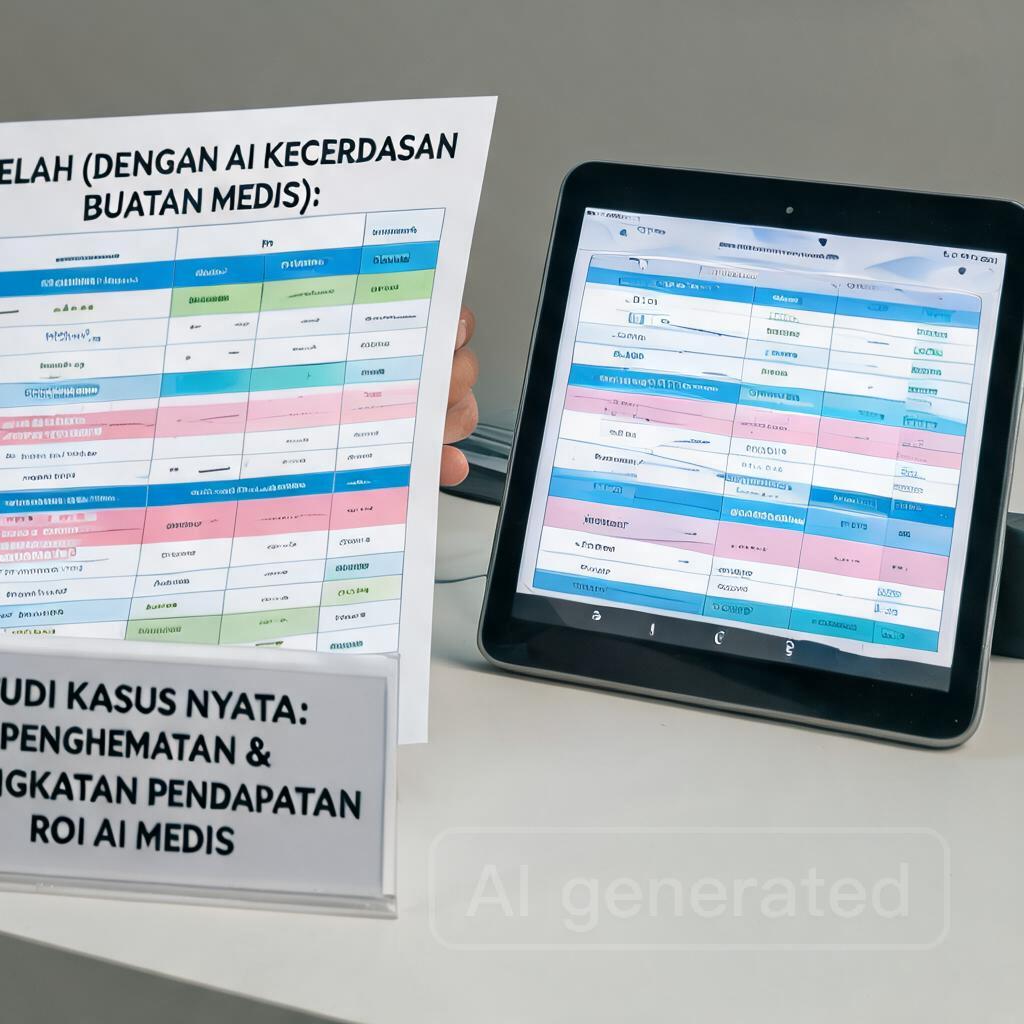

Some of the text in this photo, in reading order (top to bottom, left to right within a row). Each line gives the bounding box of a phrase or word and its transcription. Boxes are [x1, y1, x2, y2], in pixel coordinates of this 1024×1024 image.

[81, 144, 219, 188] (DENGAN
[224, 143, 256, 172] AI
[263, 131, 460, 170] KECERDASAN
[82, 178, 322, 222] BUATAN MEDIS):
[66, 681, 178, 718] KASUS
[185, 688, 309, 727] NYATA:
[0, 722, 272, 769] PENGHEMATAN &
[146, 777, 363, 820] PENDAPATAN
[29, 814, 236, 857] ROI AI MEDIS
